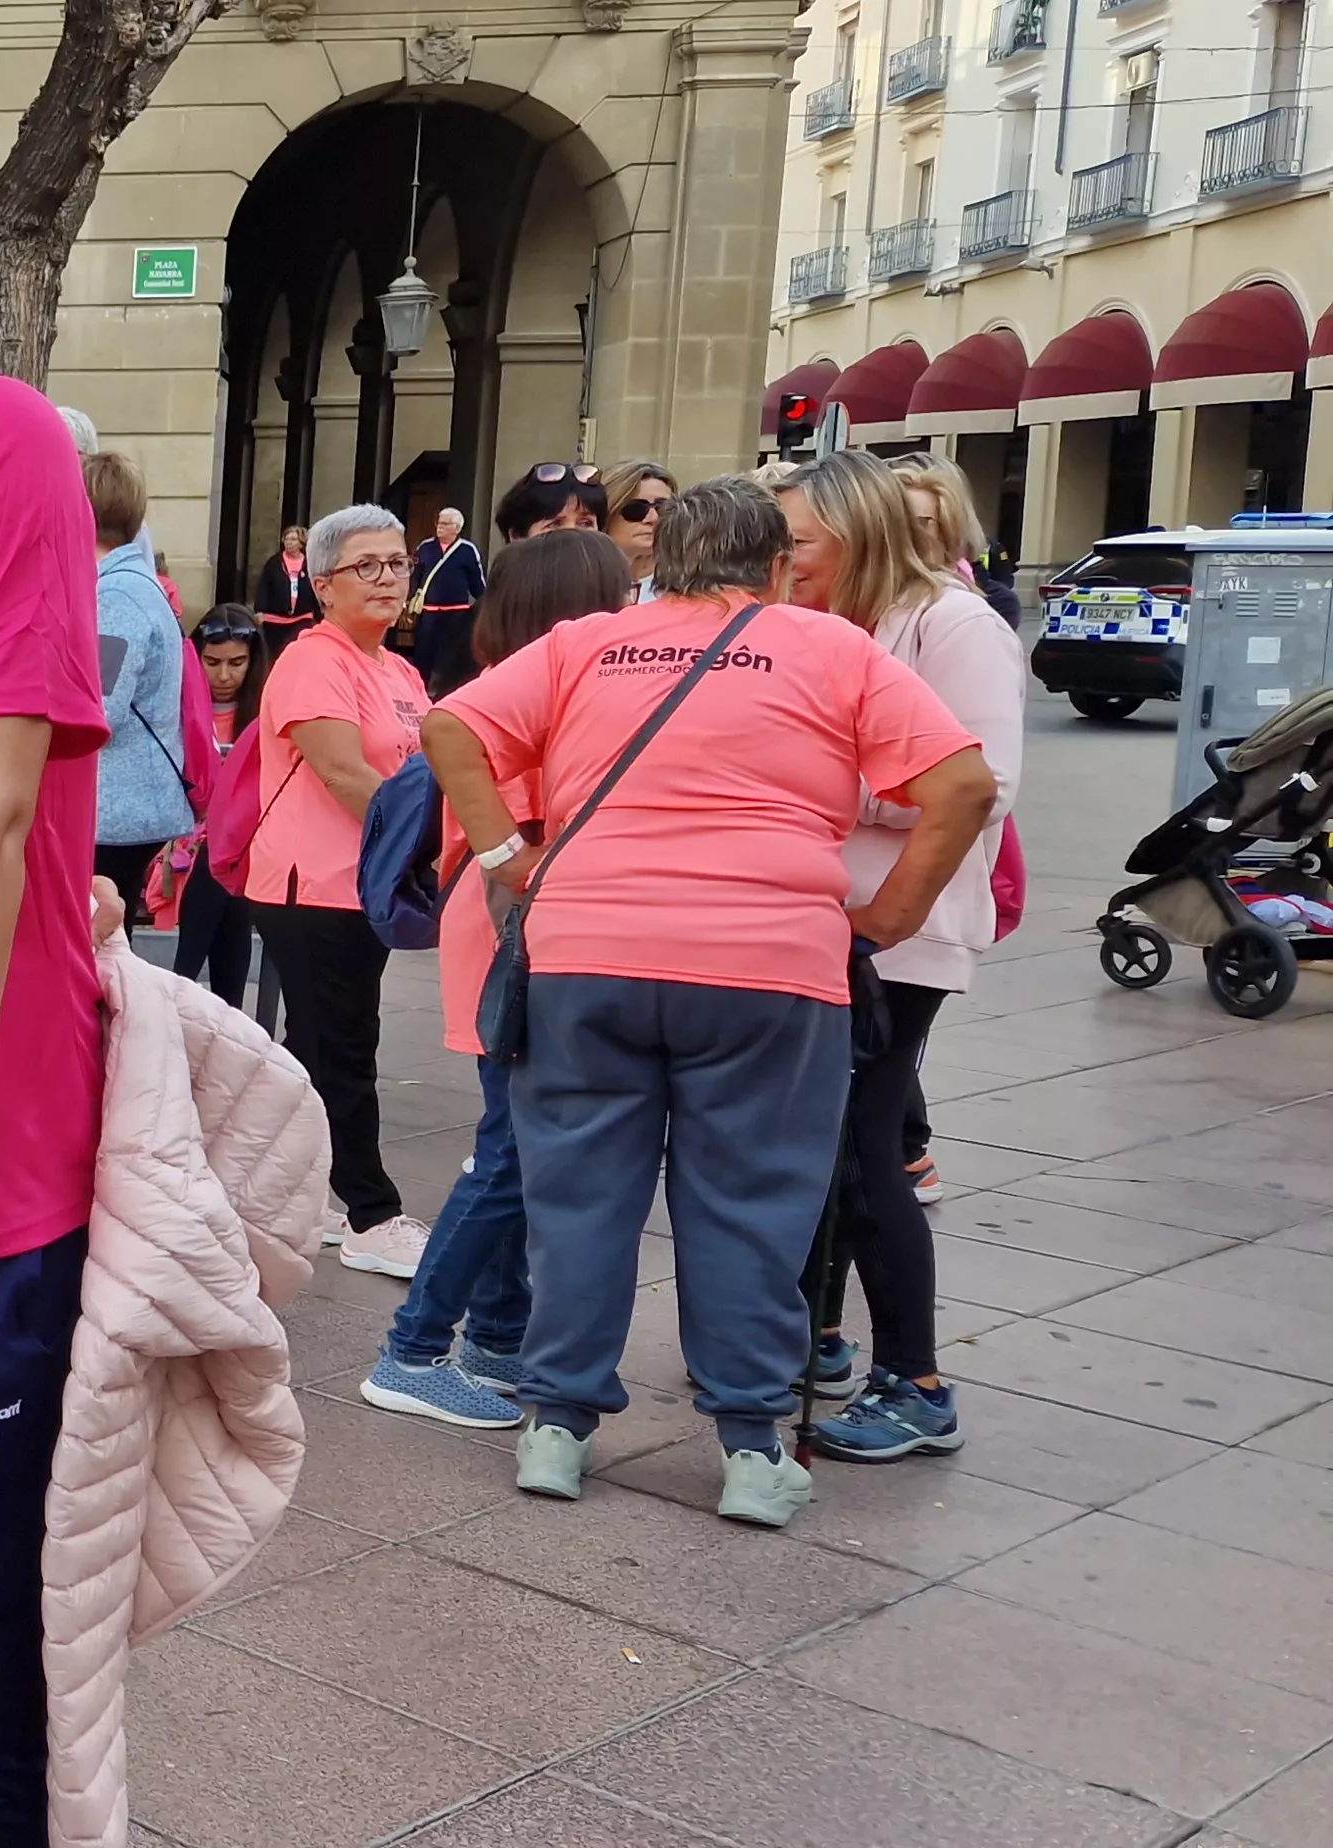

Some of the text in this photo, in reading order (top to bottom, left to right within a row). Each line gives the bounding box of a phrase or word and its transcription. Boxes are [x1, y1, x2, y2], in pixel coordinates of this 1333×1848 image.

[154, 260, 178, 269] PLAZA
[148, 270, 183, 278] NAVARRA
[1087, 608, 1134, 619] 9347 NCY
